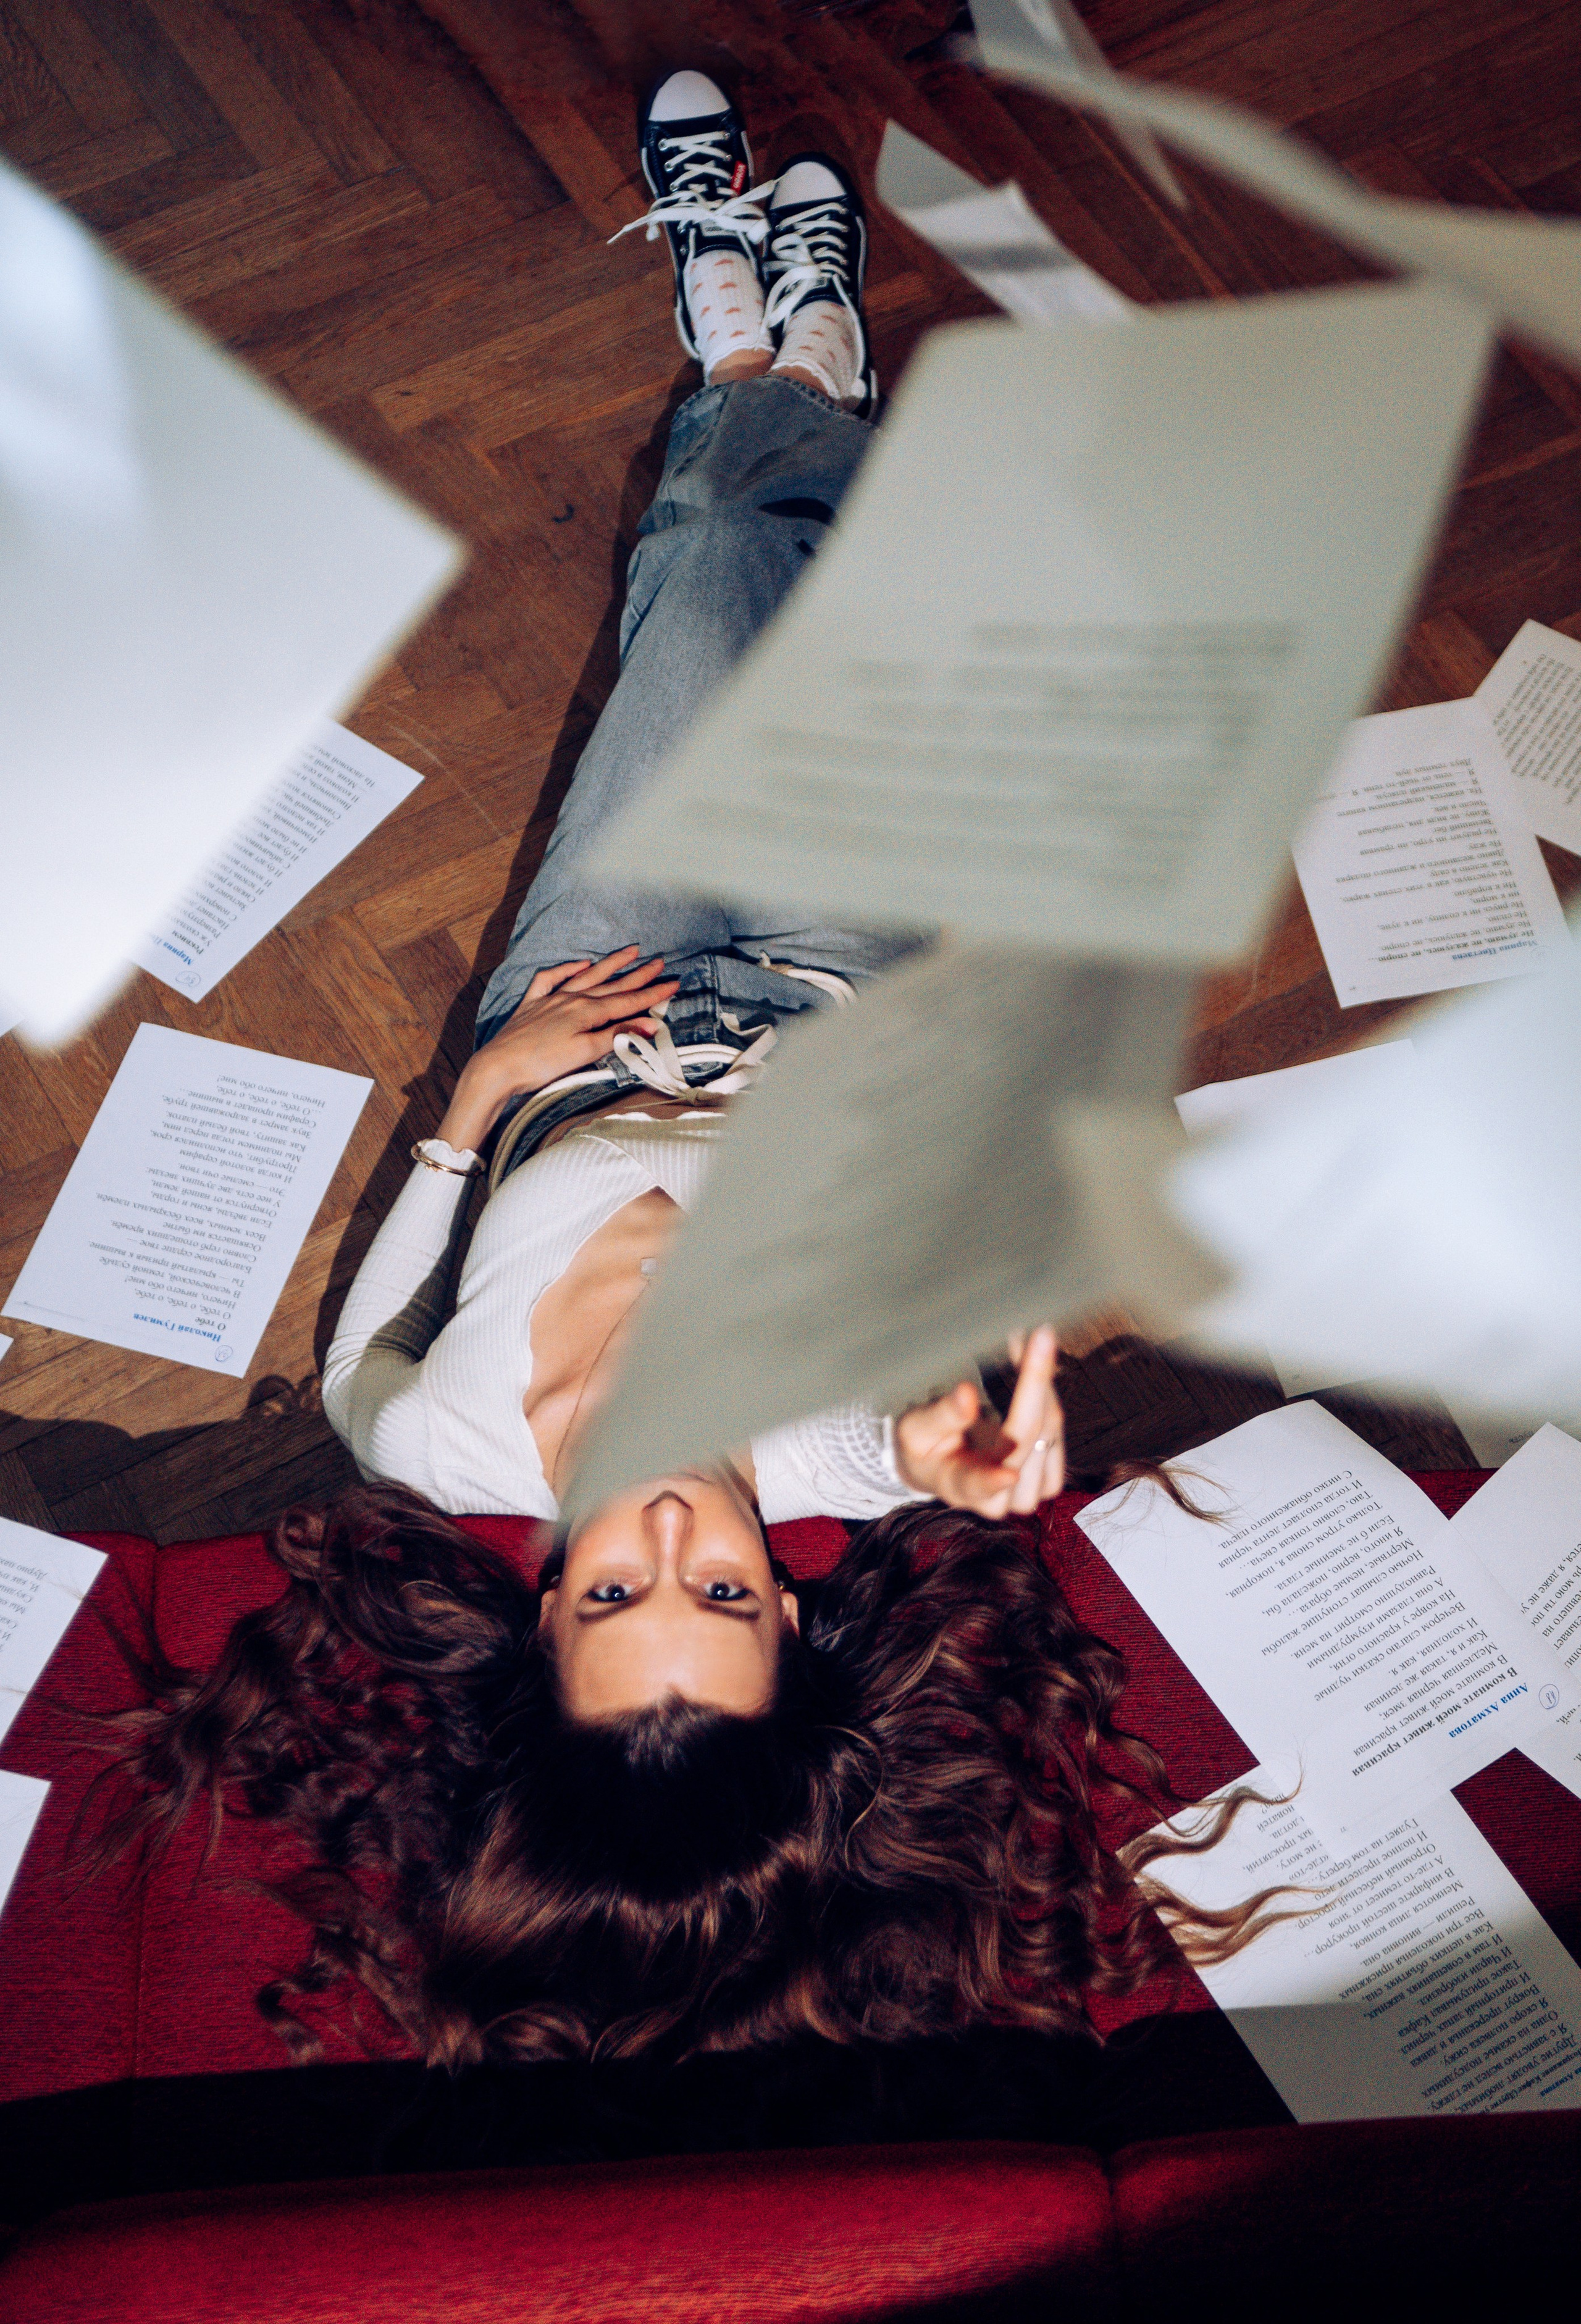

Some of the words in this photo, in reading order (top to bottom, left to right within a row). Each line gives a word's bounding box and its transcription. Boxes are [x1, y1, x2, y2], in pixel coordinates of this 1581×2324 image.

[1313, 1474, 1342, 1494] низко
[1342, 1469, 1352, 1478] С
[1351, 1479, 1362, 1489] И
[1323, 1485, 1352, 1503] тогда
[1344, 1490, 1370, 1505] Таю,
[1250, 1491, 1313, 1531] обнаженного
[1281, 1500, 1323, 1530] сползает
[1312, 1504, 1346, 1528] словно
[1345, 1501, 1380, 1524] Только
[1314, 1519, 1346, 1544] утром
[1359, 1530, 1369, 1539] б
[1367, 1514, 1394, 1533] Если
[1393, 1526, 1404, 1537] Я
[1217, 1528, 1250, 1549] плеча.
[1252, 1526, 1281, 1547] лента
[1278, 1525, 1313, 1549] тонкая
[1346, 1535, 1360, 1547] не
[1359, 1532, 1393, 1553] иного,
[1218, 1545, 1253, 1569] черная
[1285, 1540, 1315, 1561] снова
[1304, 1544, 1347, 1573] змеиные
[1364, 1537, 1414, 1569] Мертвые,
[1388, 1549, 1424, 1574] Ночью
[1274, 1558, 1286, 1567] я,
[1327, 1552, 1361, 1574] верно,
[1557, 1563, 1566, 1572] я
[1225, 1565, 1276, 1599] покорная,
[1273, 1570, 1304, 1590] глаза.
[1280, 1573, 1328, 1607] пожелала
[1333, 1567, 1365, 1592] немые
[1350, 1571, 1388, 1600] слышат
[1373, 1565, 1436, 1607] Равнодушно
[1433, 1576, 1444, 1587] А
[1537, 1569, 1560, 1594] даже
[1554, 1578, 1575, 1599] мою
[1414, 1584, 1434, 1599] она
[1438, 1589, 1456, 1602] На
[1527, 1592, 1540, 1605] не
[1261, 1603, 1281, 1617] бы,
[1301, 1596, 1349, 1631] стонущие
[1375, 1595, 1415, 1624] глазами
[1409, 1599, 1439, 1621] ковре
[1420, 1601, 1466, 1632] Вечером
[1542, 1599, 1558, 1613] ты
[1553, 1590, 1581, 1626] евшего
[1333, 1603, 1374, 1633] смотрит
[1402, 1615, 1411, 1626] у
[1466, 1616, 1478, 1629] И
[1319, 1631, 1333, 1642] на
[1356, 1623, 1402, 1655] красного
[1415, 1623, 1466, 1657] холодная,
[1466, 1629, 1488, 1646] Как
[1541, 1624, 1555, 1637] на
[1260, 1628, 1301, 1657] жалобы
[1290, 1639, 1319, 1659] меня.
[1306, 1621, 1376, 1670] изумрудными
[1385, 1629, 1421, 1655] слагаю
[1446, 1647, 1458, 1657] я,
[1457, 1642, 1467, 1651] и
[1328, 1652, 1357, 1671] огня,
[1351, 1652, 1385, 1678] сказки
[1398, 1655, 1417, 1671] как
[1419, 1655, 1448, 1676] такая
[1441, 1641, 1499, 1681] Медленная
[1496, 1653, 1509, 1665] В
[1388, 1667, 1399, 1676] я.
[1404, 1673, 1420, 1686] же
[1455, 1660, 1497, 1691] комнате
[1506, 1666, 1518, 1678] В
[1314, 1675, 1352, 1702] чудные
[1363, 1682, 1404, 1712] ленивая
[1406, 1679, 1442, 1703] черная
[1428, 1687, 1456, 1709] моей
[1462, 1673, 1507, 1705] комнате
[1499, 1682, 1529, 1704] Анна
[1378, 1700, 1407, 1721] змея;
[1398, 1704, 1430, 1728] живет
[1435, 1702, 1462, 1724] моей
[1448, 1701, 1499, 1738] Ахматова
[1352, 1724, 1398, 1757] красивая
[1402, 1720, 1436, 1744] живет
[1351, 1741, 1402, 1777] красивая
[1269, 1817, 1299, 1839] дотла.
[1384, 1818, 1419, 1842] Гуляет
[1415, 1830, 1428, 1842] И
[1304, 1843, 1317, 1855] не
[1351, 1847, 1370, 1862] том
[1370, 1838, 1384, 1850] на
[1381, 1836, 1416, 1861] полное
[1242, 1837, 1297, 1874] проклятий,
[1276, 1851, 1304, 1870] могу.
[1384, 1843, 1436, 1879] Огромный
[1433, 1854, 1444, 1865] А
[1336, 1857, 1382, 1888] прелести
[1403, 1860, 1435, 1884] где-то
[1443, 1866, 1455, 1878] В
[1335, 1873, 1385, 1907] небесный
[1364, 1880, 1404, 1907] темнеет
[1397, 1873, 1444, 1905] инфаркте
[1412, 1879, 1464, 1914] Меняются
[1352, 1904, 1364, 1915] от
[1361, 1901, 1398, 1929] шестой
[1387, 1909, 1412, 1928] лица
[1435, 1895, 1476, 1923] Решили
[1464, 1908, 1485, 1924] Все
[1328, 1912, 1352, 1929] зноя
[1445, 1920, 1464, 1935] три
[1471, 1920, 1495, 1937] Как
[1349, 1925, 1388, 1950] конвоя,
[1381, 1927, 1422, 1955] виновна
[1464, 1933, 1473, 1941] в
[1359, 1952, 1382, 1967] она.
[1394, 1931, 1446, 1966] поколенья
[1428, 1937, 1465, 1963] цепких
[1338, 1962, 1395, 2000] присяжных
[1383, 1959, 1429, 1991] объятиях
[1361, 1987, 1384, 2002] сна,
